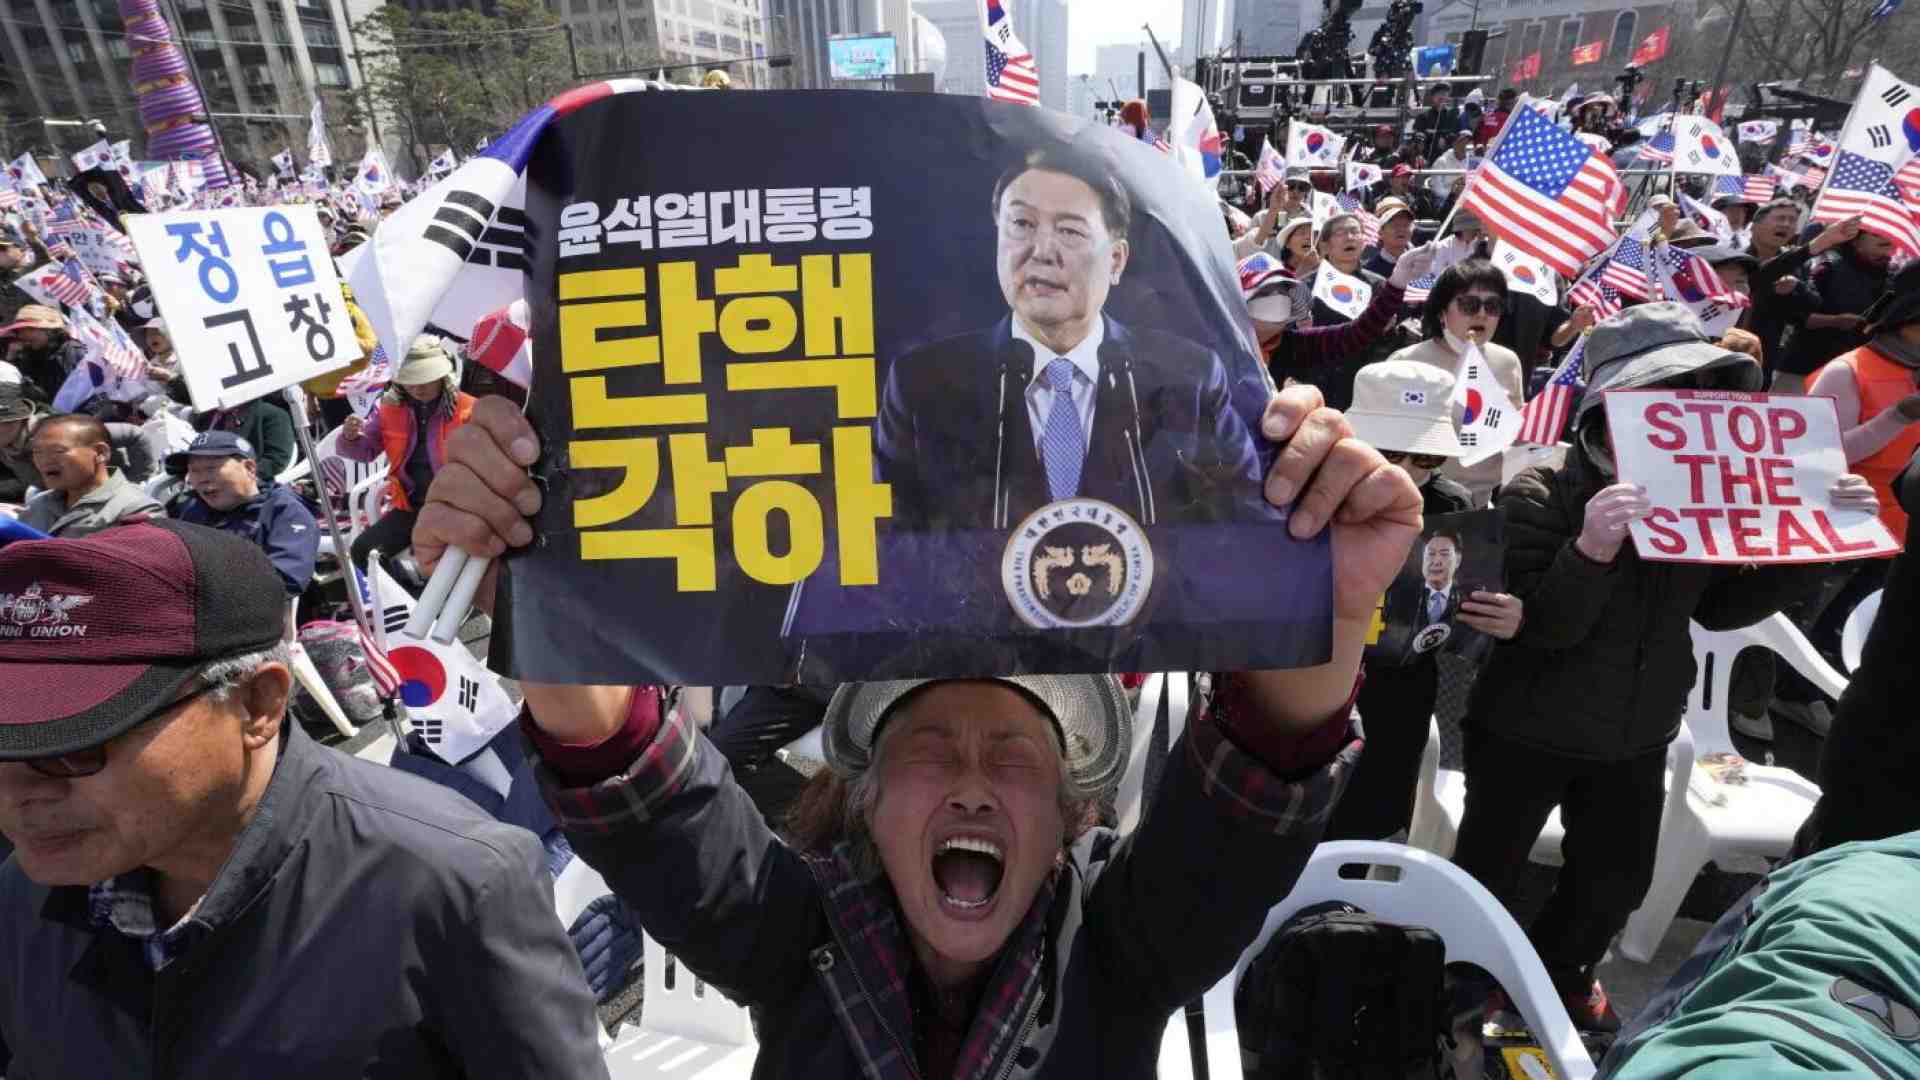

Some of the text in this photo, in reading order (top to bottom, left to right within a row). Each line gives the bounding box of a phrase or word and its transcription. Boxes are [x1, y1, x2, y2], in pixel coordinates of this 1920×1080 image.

[558, 187, 873, 258] 윤석열대통령
[559, 253, 878, 430] 탄핵
[1644, 402, 1807, 454] STOP
[1674, 454, 1802, 506] THE
[569, 426, 893, 592] 각하
[1643, 507, 1877, 557] STEAL
[31, 625, 88, 637] UNION
